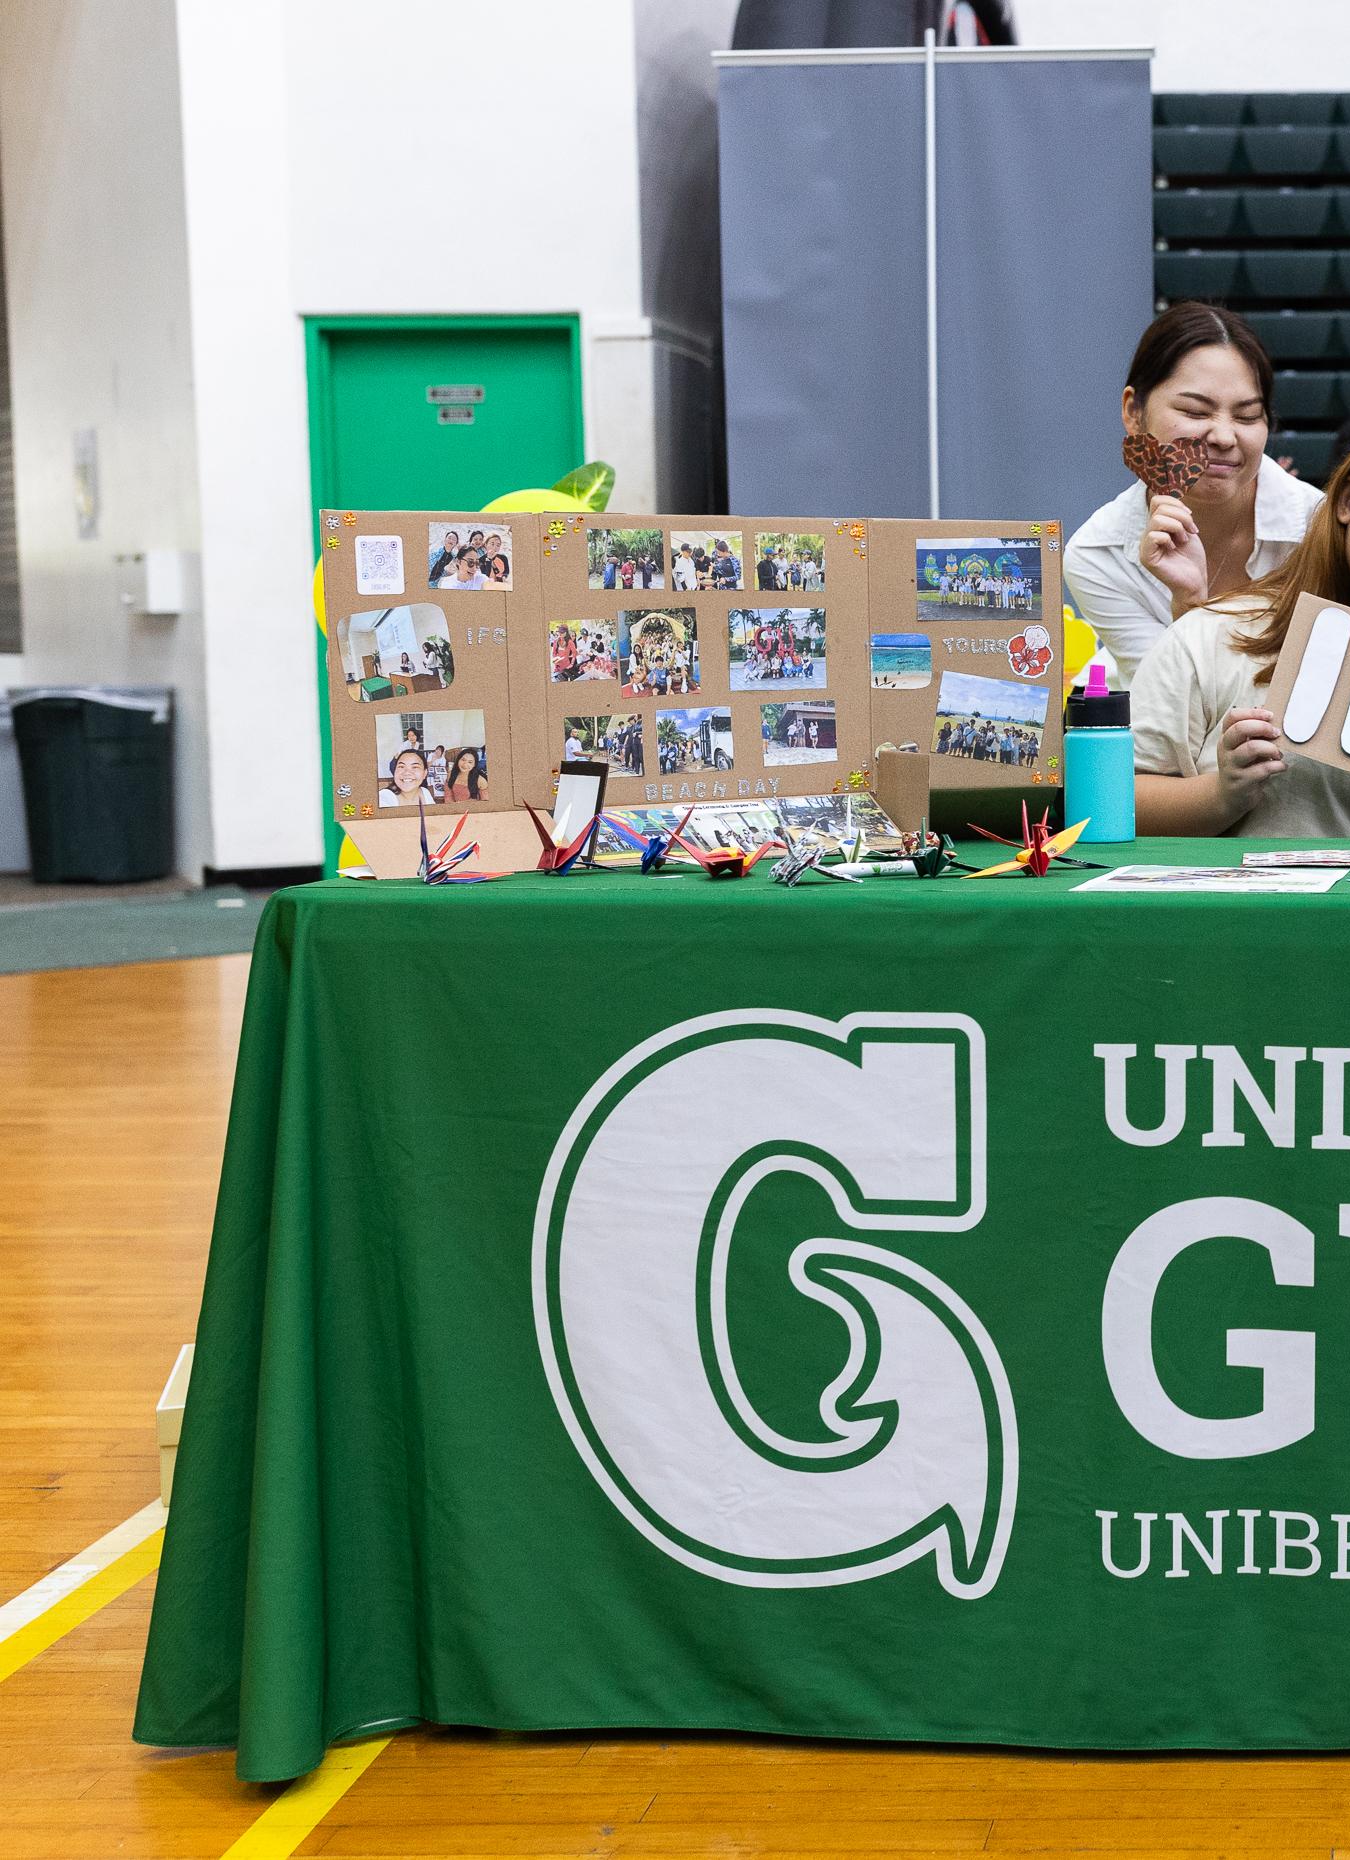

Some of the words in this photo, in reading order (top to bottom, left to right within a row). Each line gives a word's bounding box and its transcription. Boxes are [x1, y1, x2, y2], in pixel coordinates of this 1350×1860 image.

[942, 637, 1008, 654] TOURS
[644, 781, 728, 800] BEACH
[738, 777, 781, 796] DAY
